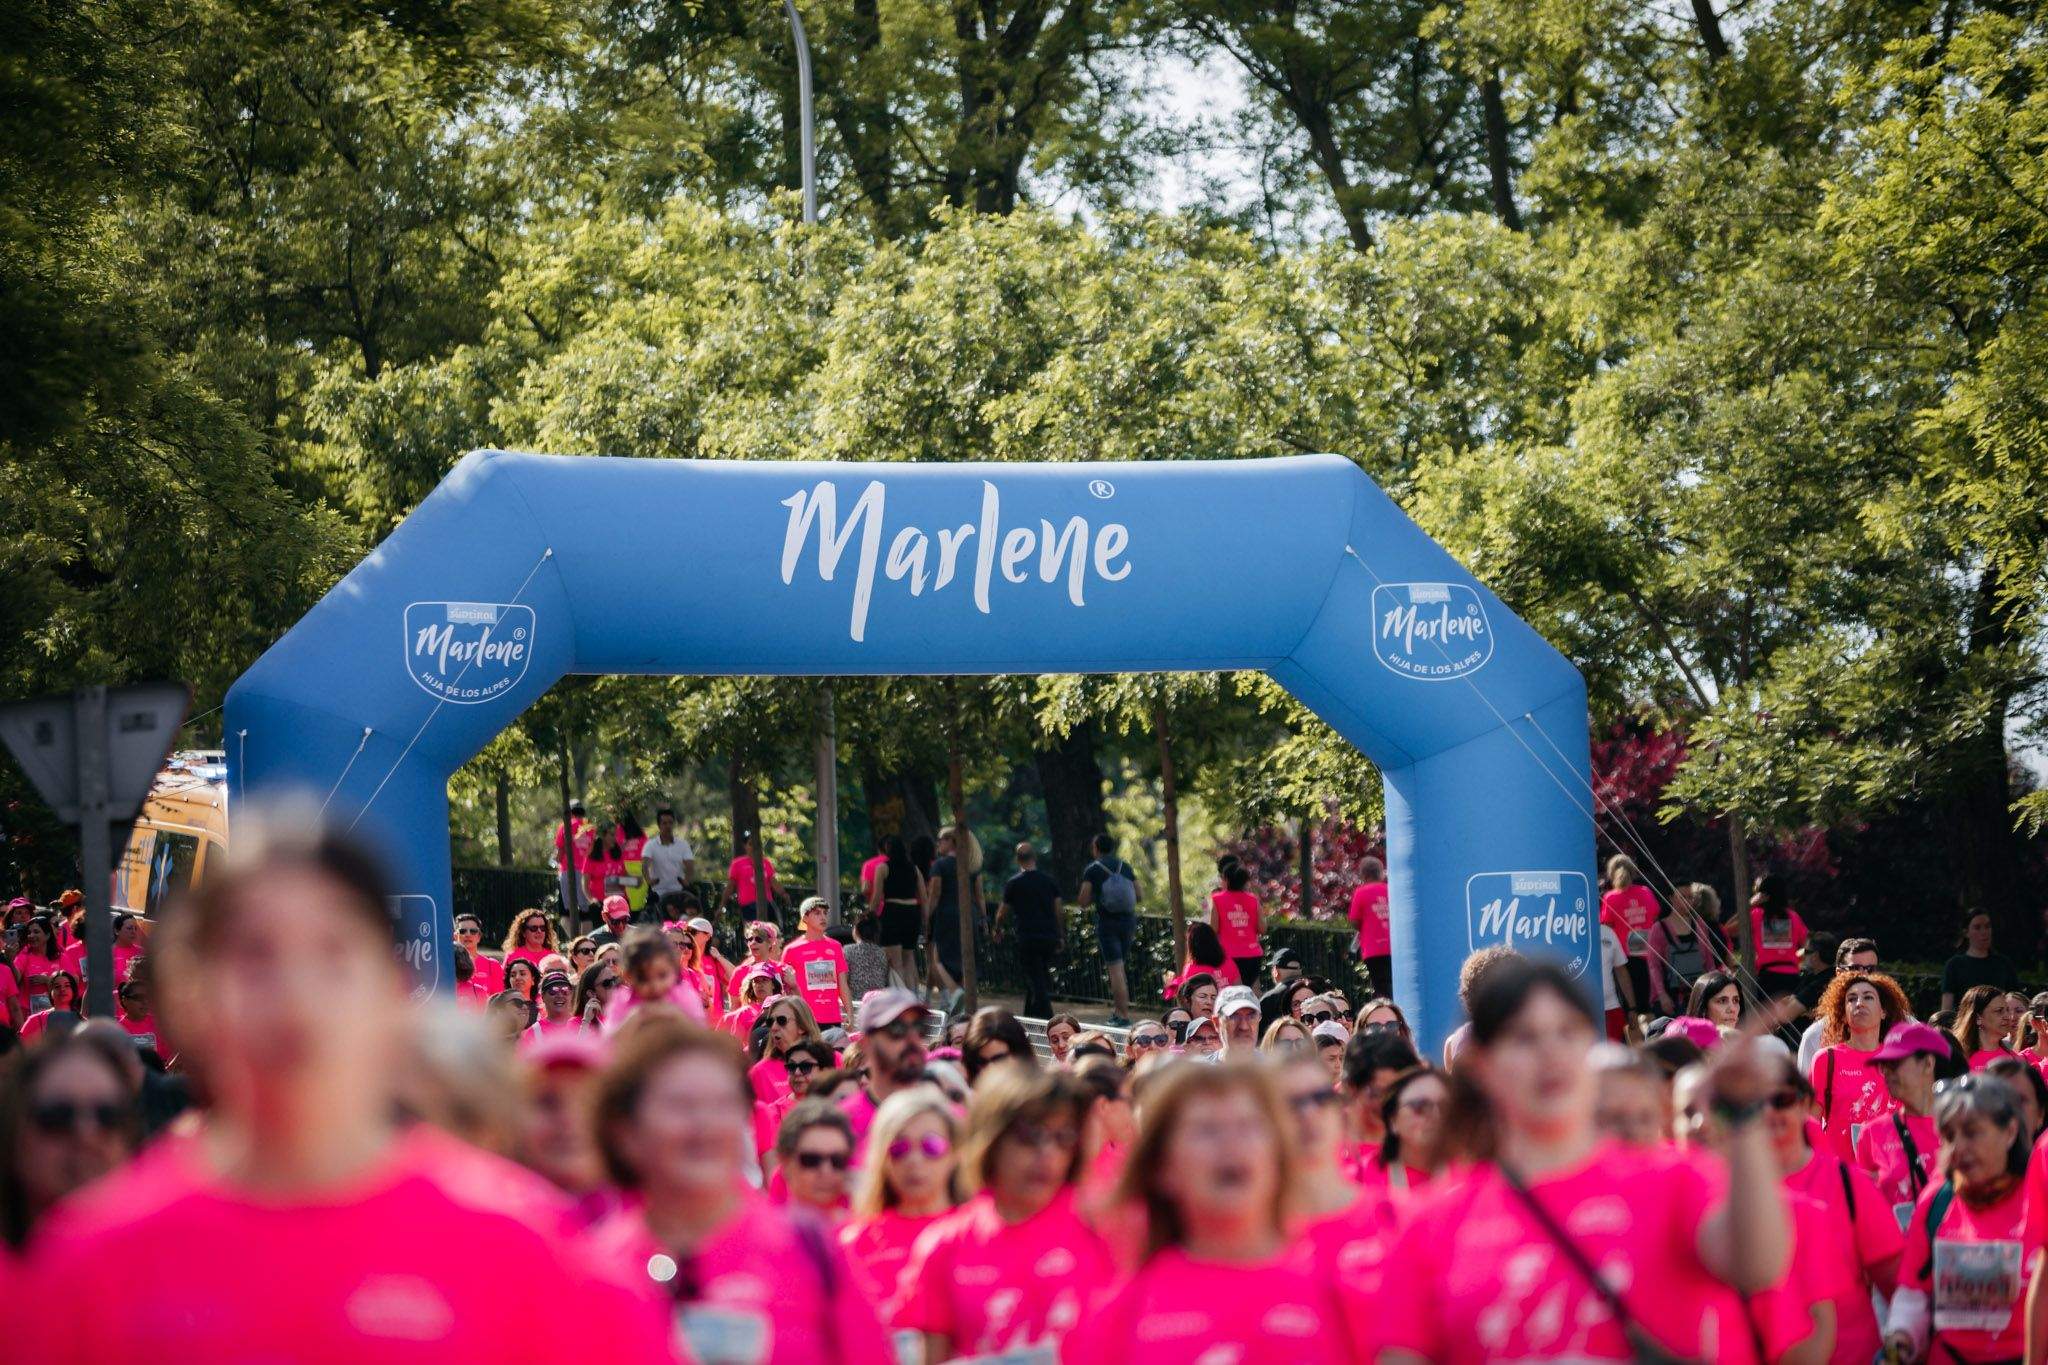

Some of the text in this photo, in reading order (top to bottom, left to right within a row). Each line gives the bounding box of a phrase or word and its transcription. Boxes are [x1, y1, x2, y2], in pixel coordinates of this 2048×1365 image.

[780, 479, 1132, 642] Marlene
[415, 623, 524, 676] Marlene
[1382, 603, 1484, 655] Marlene
[421, 671, 510, 698] HIJA DE LOS ALPES
[1389, 650, 1482, 675] HIJA DE LOS ALPES
[1478, 896, 1587, 948] Marlene
